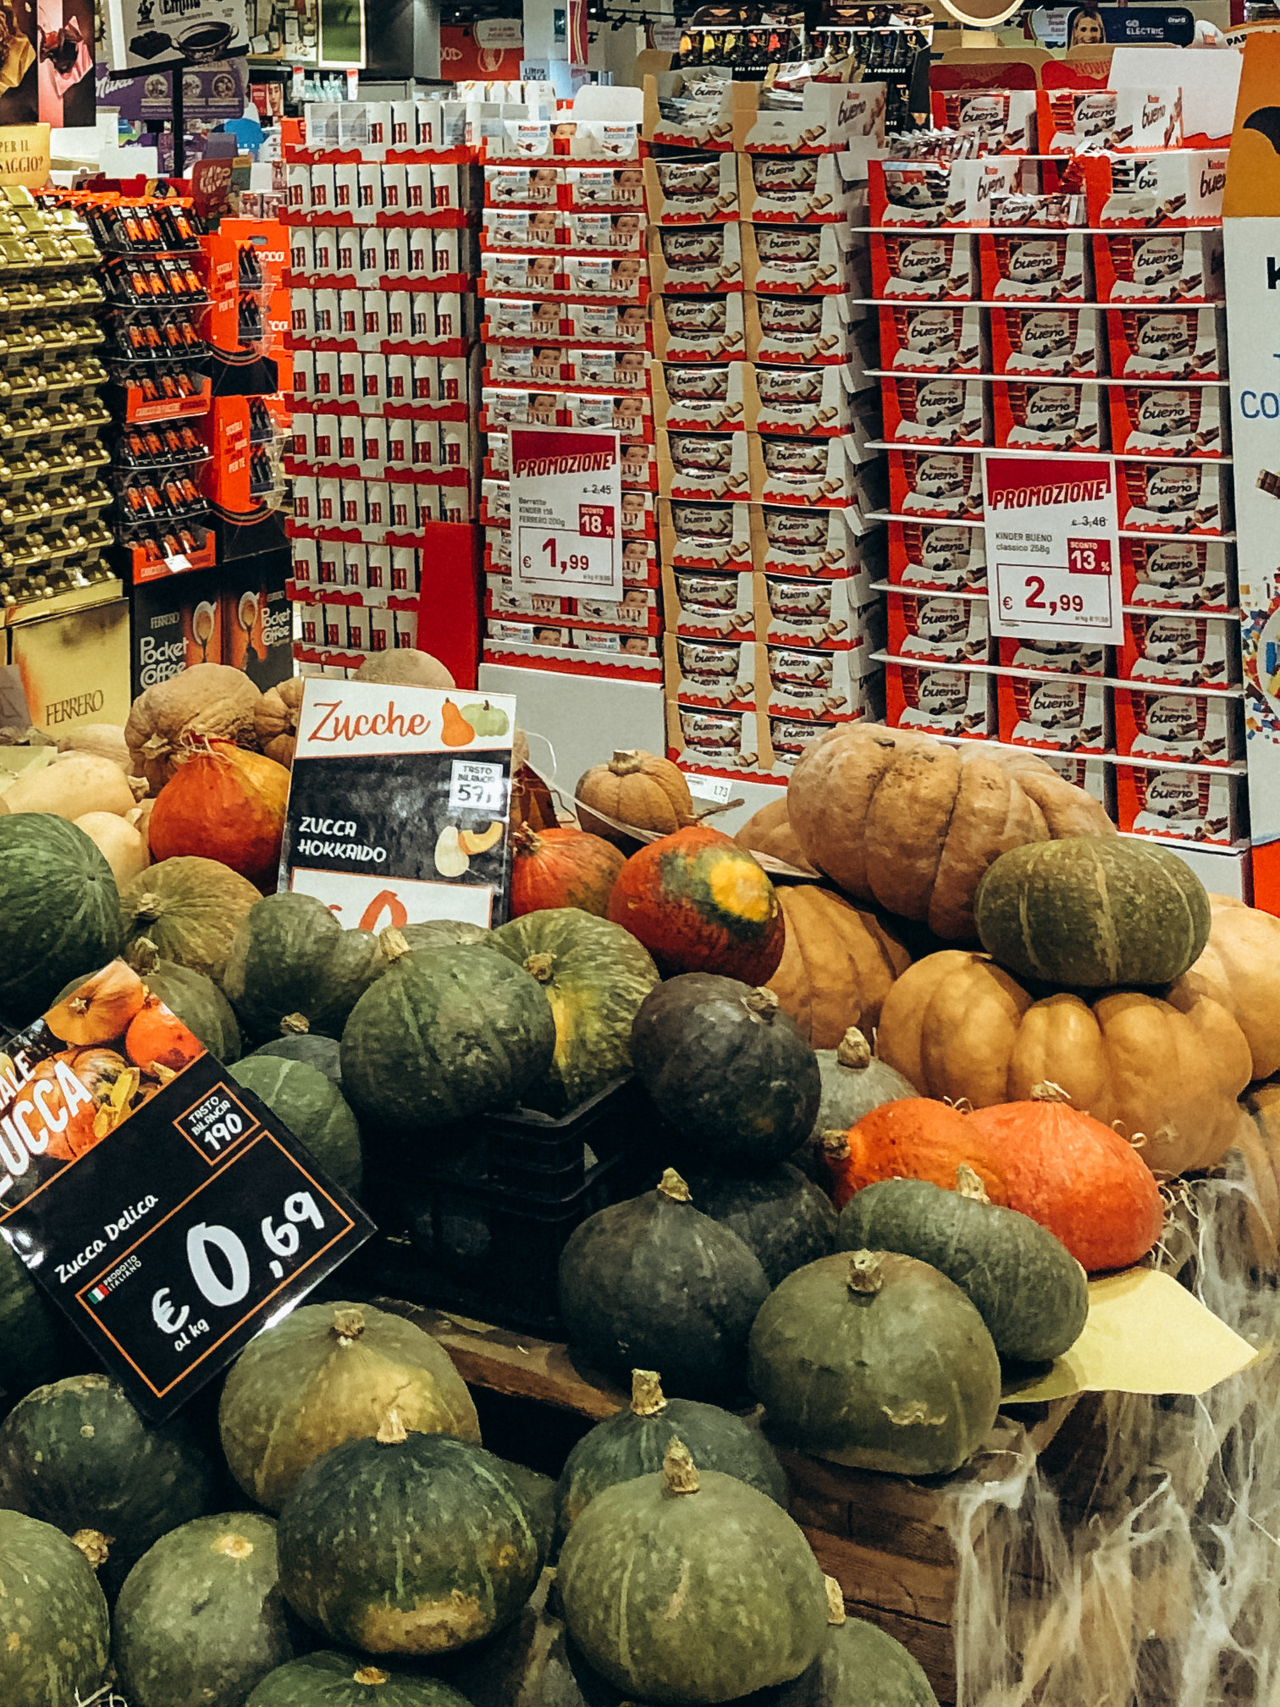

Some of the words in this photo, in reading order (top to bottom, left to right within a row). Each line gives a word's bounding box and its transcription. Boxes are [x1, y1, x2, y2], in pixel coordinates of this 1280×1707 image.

[1126, 20, 1139, 28] GO
[1126, 27, 1164, 37] ELECTRIC
[524, 67, 546, 76] Ultra
[837, 94, 867, 127] bueno
[963, 110, 1000, 124] bueno
[1077, 109, 1116, 122] bueno
[1141, 103, 1166, 129] bueno
[21, 140, 30, 152] IL
[668, 169, 697, 180] bueno
[765, 165, 796, 177] bueno
[977, 175, 1006, 203] bueno
[1002, 203, 1029, 216] bueno
[674, 238, 704, 249] bueno
[769, 238, 801, 249] bueno
[256, 252, 286, 262] occa
[903, 254, 941, 268] bueno
[1013, 256, 1053, 270] bueno
[1138, 253, 1179, 268] bueno
[676, 307, 706, 317] bueno
[772, 307, 805, 318] bueno
[911, 325, 950, 338] bueno
[1025, 327, 1066, 342] bueno
[1142, 330, 1183, 345] bueno
[677, 374, 707, 386] bueno
[770, 376, 801, 388] bueno
[920, 395, 958, 407] bueno
[1030, 401, 1070, 414] bueno
[1143, 406, 1185, 420] bueno
[681, 444, 711, 455] bueno
[776, 449, 807, 460] bueno
[516, 451, 614, 479] PROMOZIONE
[920, 469, 959, 482] bueno
[992, 479, 1108, 511] PROMOZIONE
[1150, 482, 1193, 496] bueno
[581, 515, 602, 533] 18
[683, 513, 713, 524] bueno
[778, 519, 810, 531] bueno
[996, 532, 1023, 542] KINDER
[1025, 533, 1052, 543] BUENO
[925, 540, 965, 554] bueno
[996, 544, 1028, 553] classico
[1070, 541, 1098, 550] SCONTO
[523, 555, 532, 569] €
[542, 537, 589, 575] 1,99
[1070, 550, 1096, 570] 13
[1101, 561, 1111, 573] %
[1151, 559, 1194, 573] bueno
[689, 584, 719, 595] bueno
[779, 588, 811, 599] bueno
[1003, 596, 1014, 611] €
[1024, 575, 1084, 616] 2,99
[150, 611, 180, 630] FERRERO
[261, 606, 291, 628] Pocket
[921, 612, 960, 625] bueno
[261, 625, 290, 645] Coffee
[1149, 630, 1192, 644] bueno
[140, 636, 189, 666] Pocket
[694, 652, 725, 664] bueno
[779, 656, 811, 668] bueno
[140, 660, 187, 690] Coffee
[922, 685, 961, 698] bueno
[46, 689, 104, 727] FERRERO
[1034, 698, 1074, 711] bueno
[307, 699, 431, 743] Zucche
[1150, 710, 1193, 724] bueno
[693, 721, 724, 732] bueno
[783, 726, 815, 739] bueno
[463, 765, 492, 775] TASTO
[1150, 787, 1193, 800] bueno
[299, 816, 357, 837] ZUCCA
[297, 839, 387, 863] HOKKAIDO
[187, 1095, 221, 1124] TASTO
[191, 1099, 232, 1136] BILANCIA
[203, 1112, 244, 1151] 190
[53, 1239, 108, 1285] Zucca
[106, 1194, 159, 1240] Delica
[151, 1287, 191, 1335] €
[186, 1190, 326, 1309] 0,69
[103, 1254, 138, 1287] PRODOTTO
[107, 1260, 143, 1293] ITALIANO
[173, 1331, 192, 1353] al
[189, 1316, 211, 1341] kg
